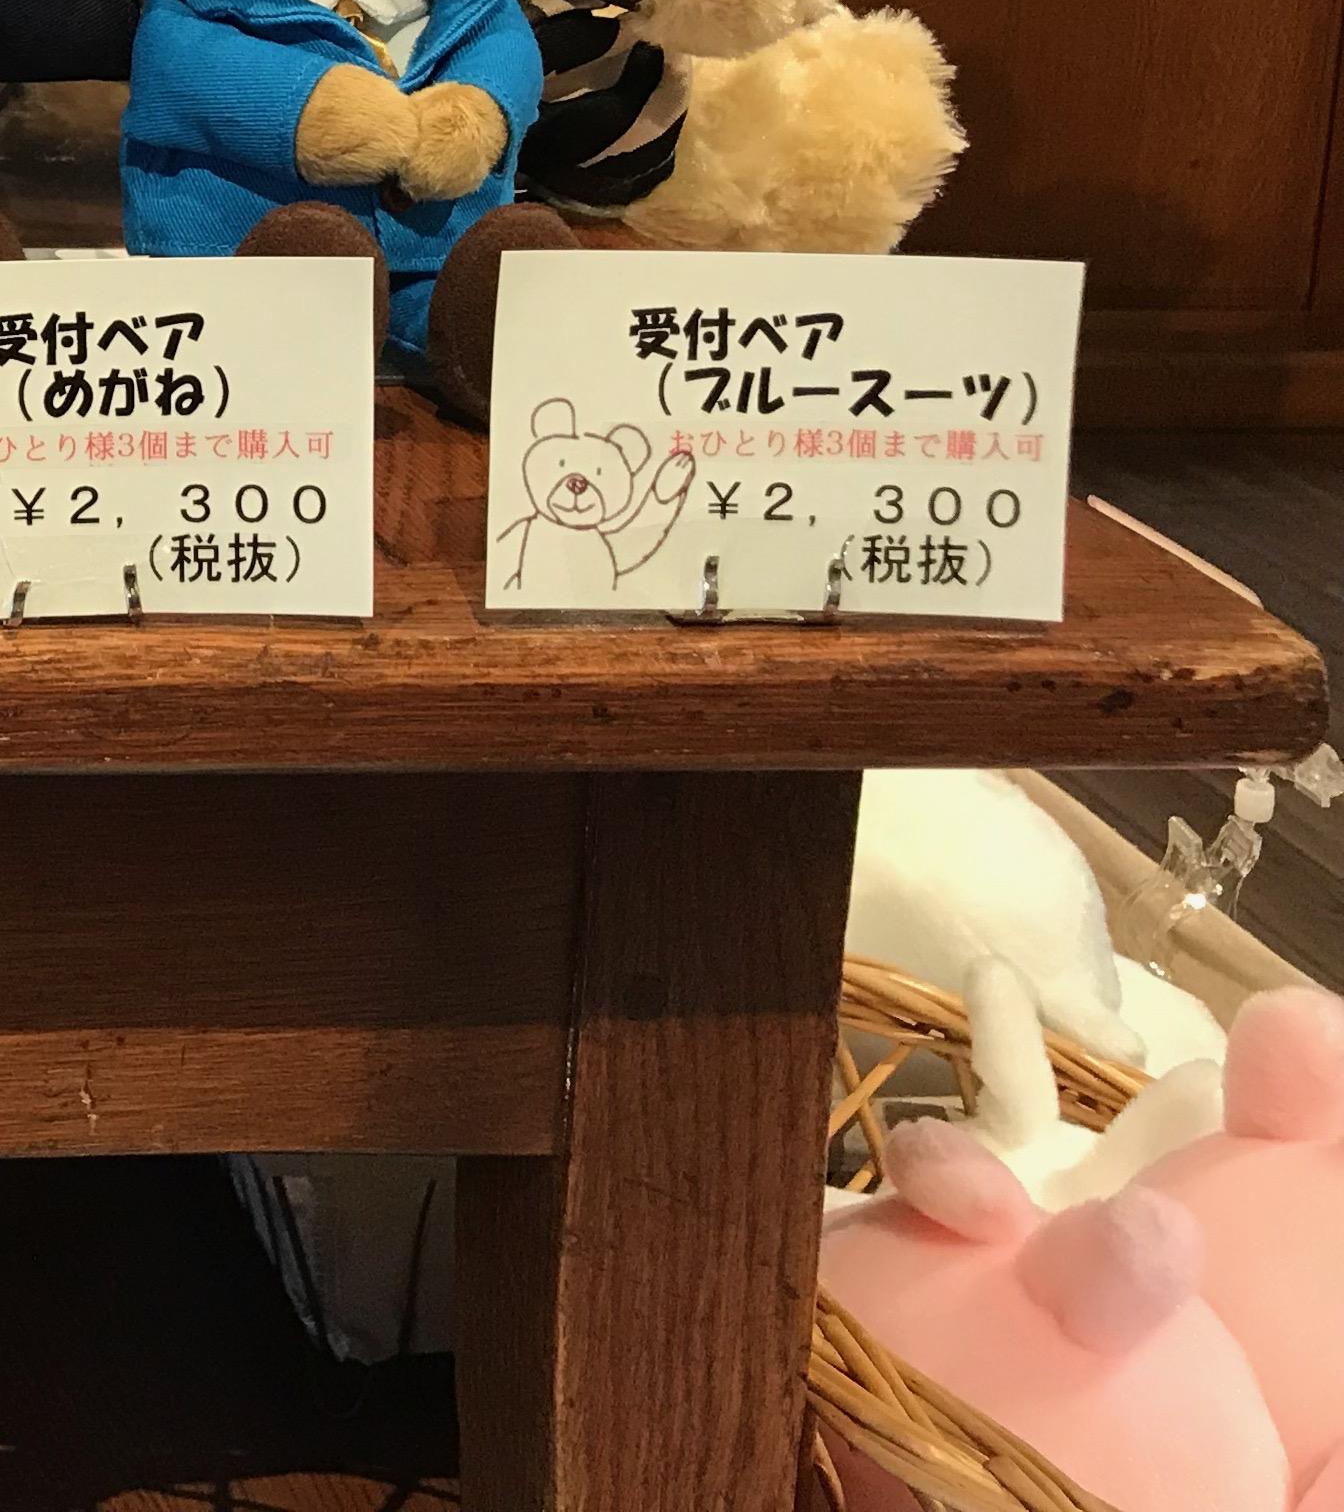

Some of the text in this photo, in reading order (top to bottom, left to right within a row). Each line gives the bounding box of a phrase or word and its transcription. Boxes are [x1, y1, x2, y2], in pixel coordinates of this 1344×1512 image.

[629, 306, 845, 362] 受付ベア
[17, 365, 231, 423] (めがね)
[667, 428, 1046, 464] おひとり様3個まで購入可
[148, 533, 302, 585] (税抜)
